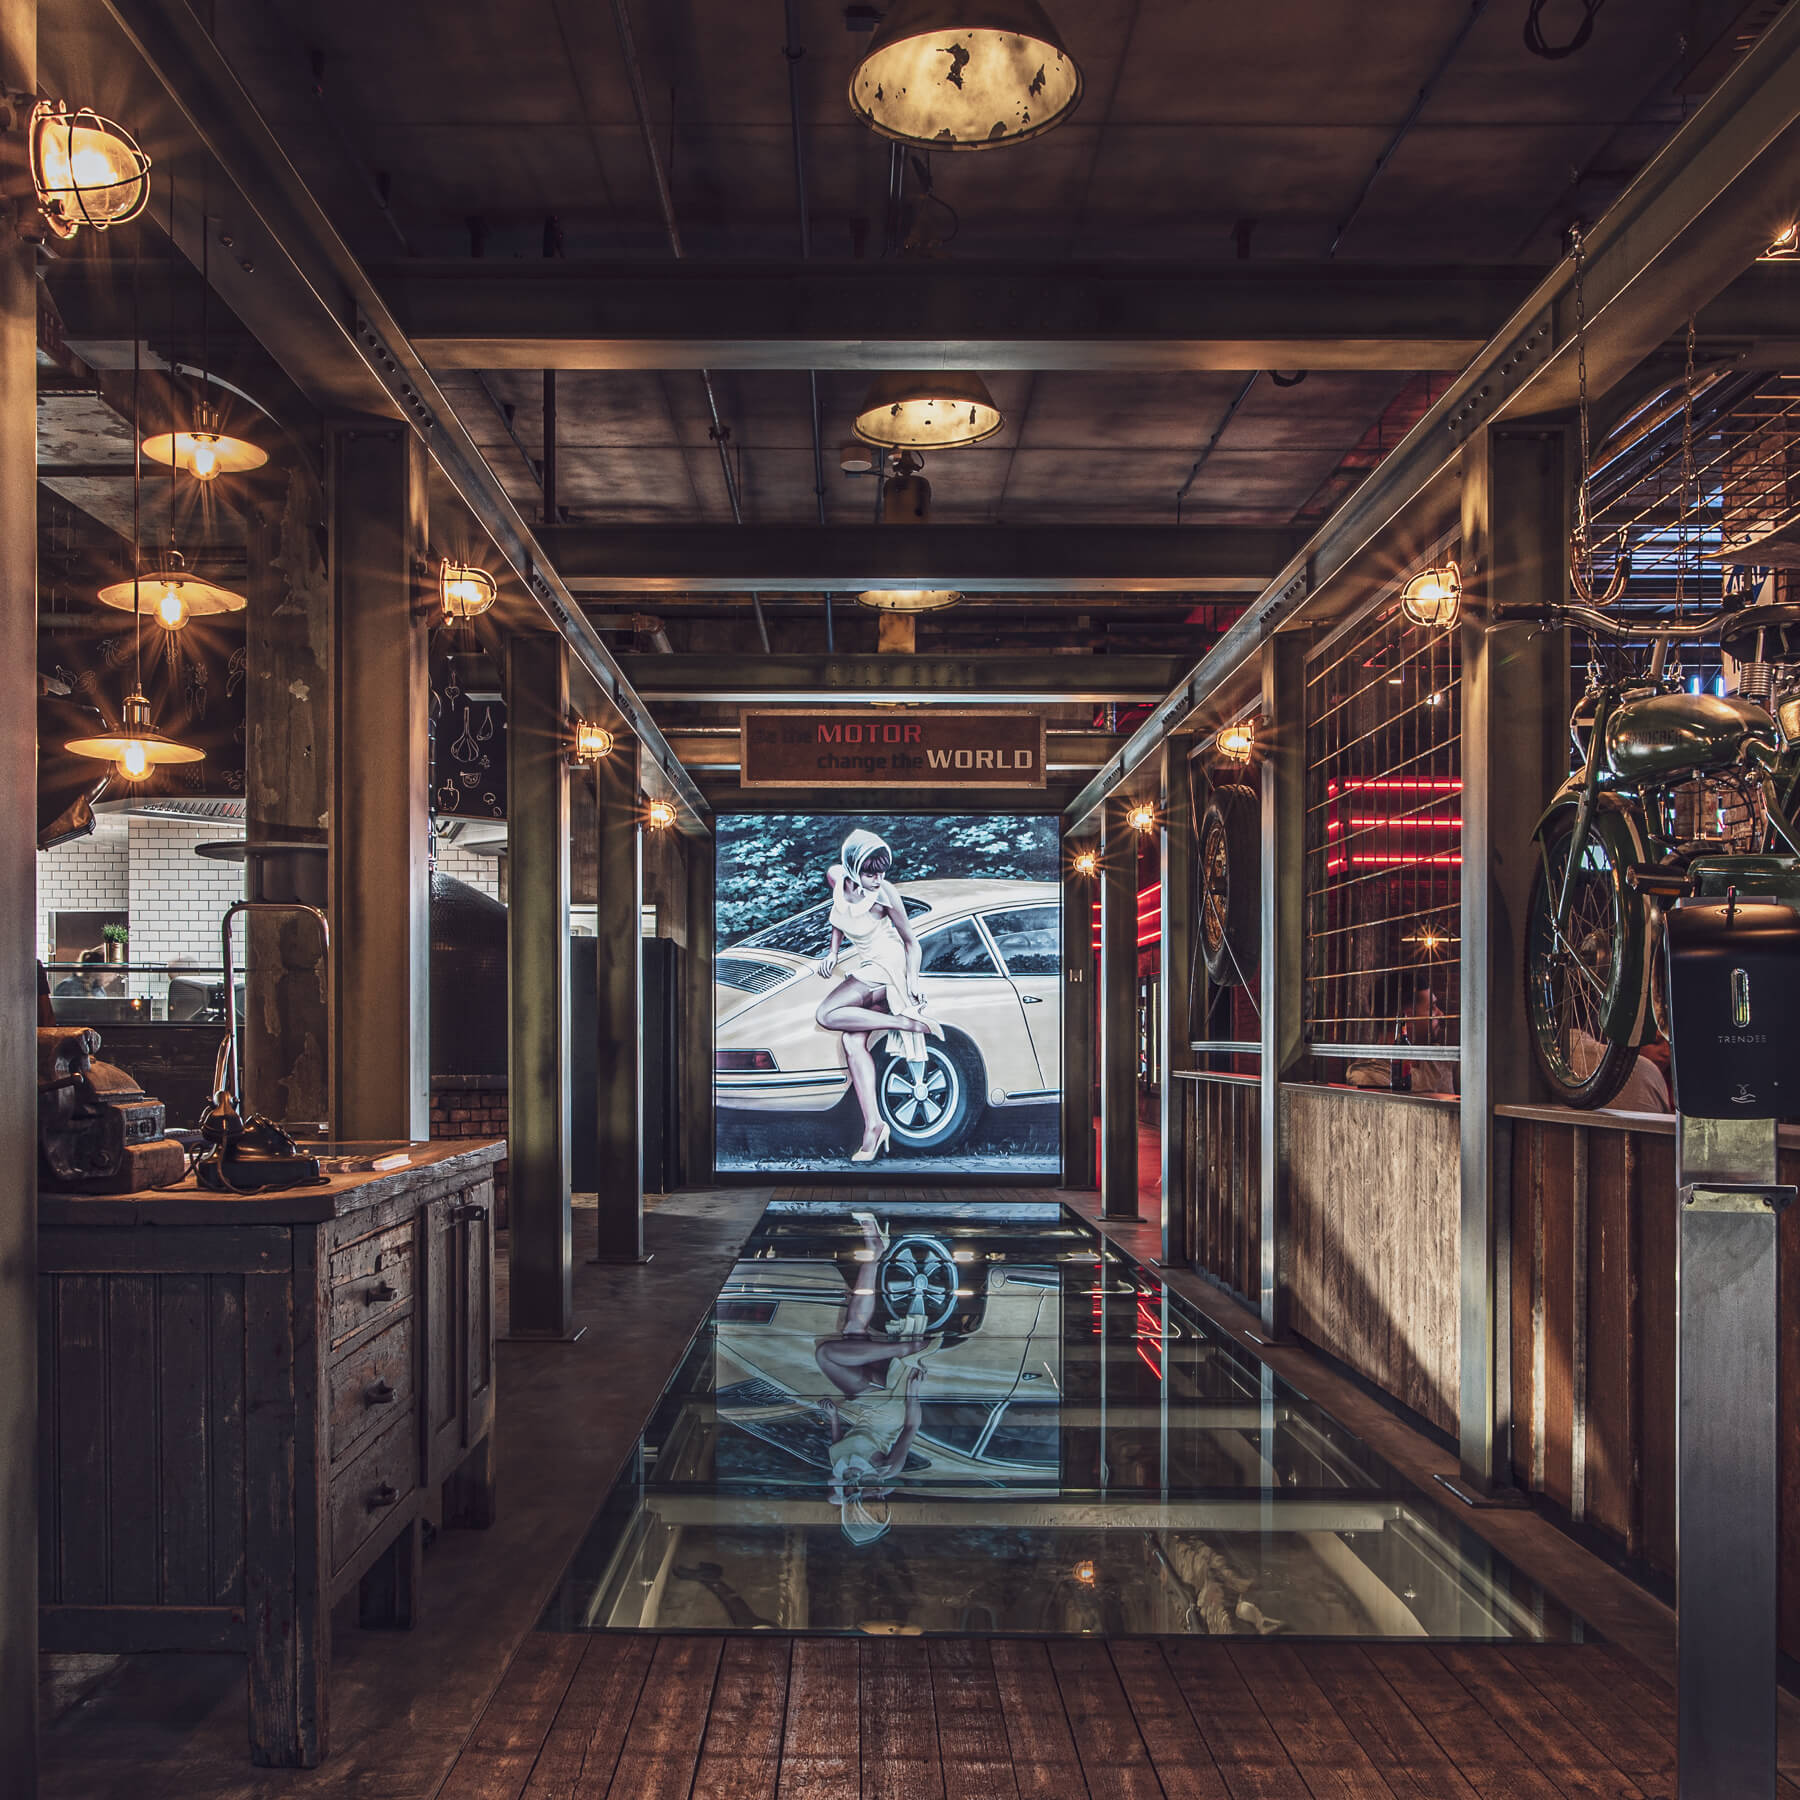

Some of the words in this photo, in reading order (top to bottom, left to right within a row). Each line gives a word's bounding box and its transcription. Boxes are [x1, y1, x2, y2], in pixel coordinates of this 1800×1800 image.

[817, 724, 922, 743] MOTOR
[817, 753, 888, 773] change
[891, 753, 923, 769] the
[926, 749, 1033, 769] WORLD
[1717, 1035, 1767, 1044] TRENDEE
